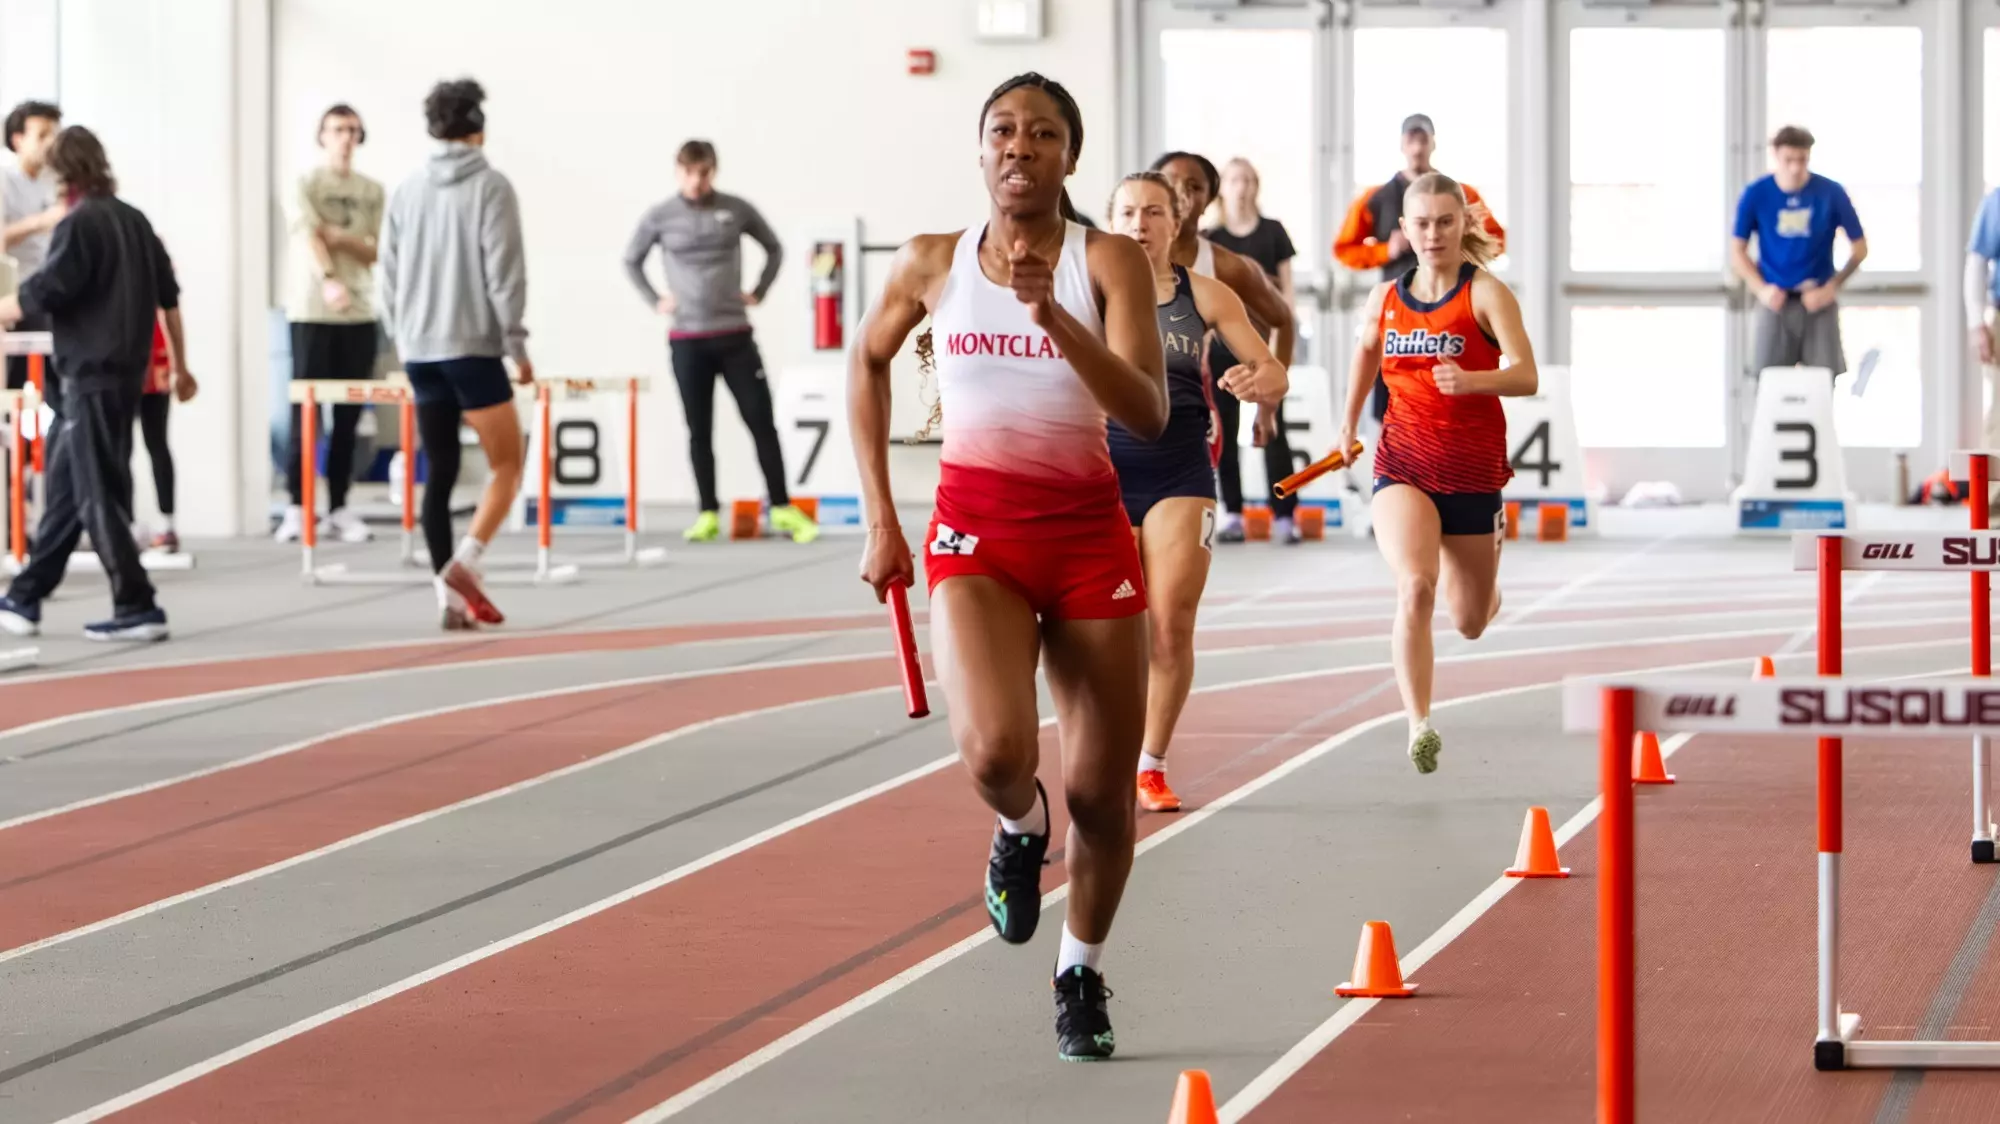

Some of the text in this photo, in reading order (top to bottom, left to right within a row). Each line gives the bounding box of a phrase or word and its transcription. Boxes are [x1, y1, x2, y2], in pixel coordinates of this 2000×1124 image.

[946, 332, 1065, 359] MONTCLA
[1165, 332, 1199, 360] ATA
[1384, 330, 1465, 356] Bullets
[555, 421, 600, 486] 8
[795, 420, 830, 485] 7
[1510, 420, 1561, 487] 4
[1774, 423, 1818, 489] 3
[1862, 537, 2000, 565] GILL SU
[1664, 689, 2000, 725] GILL SUSQUE
